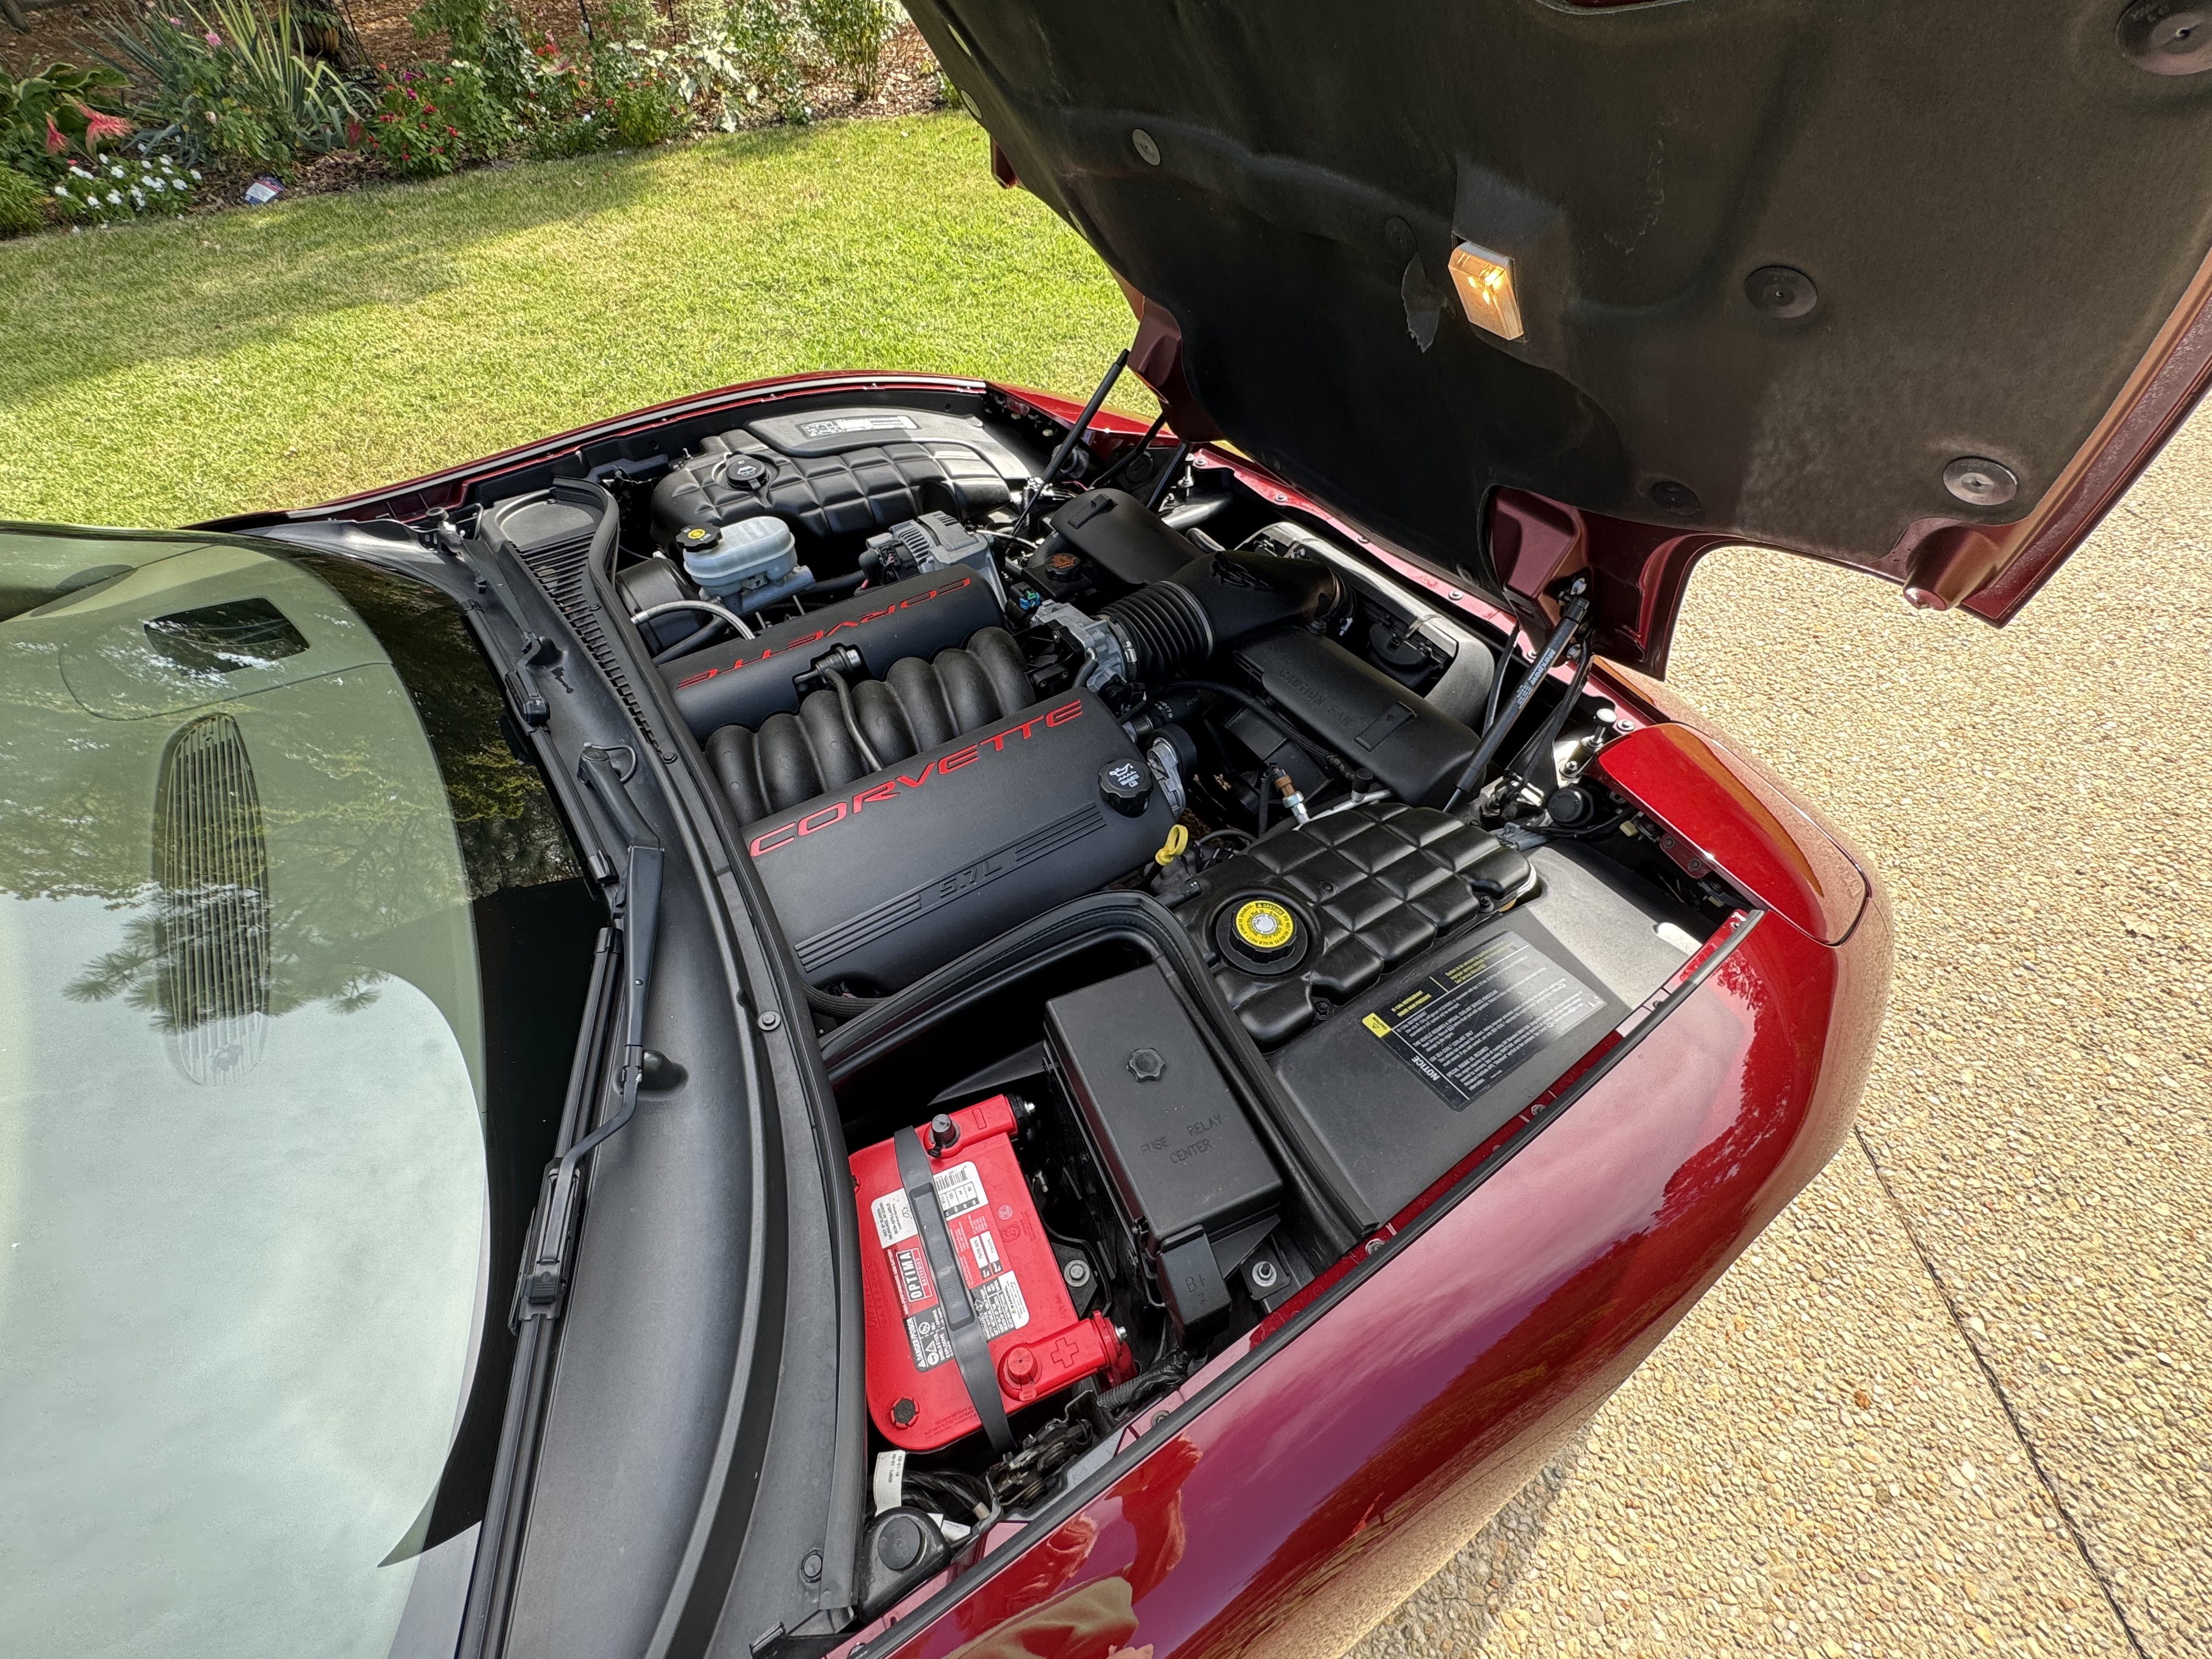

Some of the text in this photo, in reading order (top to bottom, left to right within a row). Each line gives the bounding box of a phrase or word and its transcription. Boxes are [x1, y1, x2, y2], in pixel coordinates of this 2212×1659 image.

[677, 578, 970, 690] CORVETTE
[749, 699, 1082, 857] CORVETTE
[939, 861, 1002, 899] 5.7L
[1263, 904, 1284, 915] CAUTION
[1410, 1054, 1441, 1081] NOTICE
[1141, 1114, 1222, 1156] FUSE RELAY
[1169, 1138, 1213, 1164] CENTER
[899, 1251, 922, 1300] OPTIMA
[915, 1257, 927, 1286] BATTERIES
